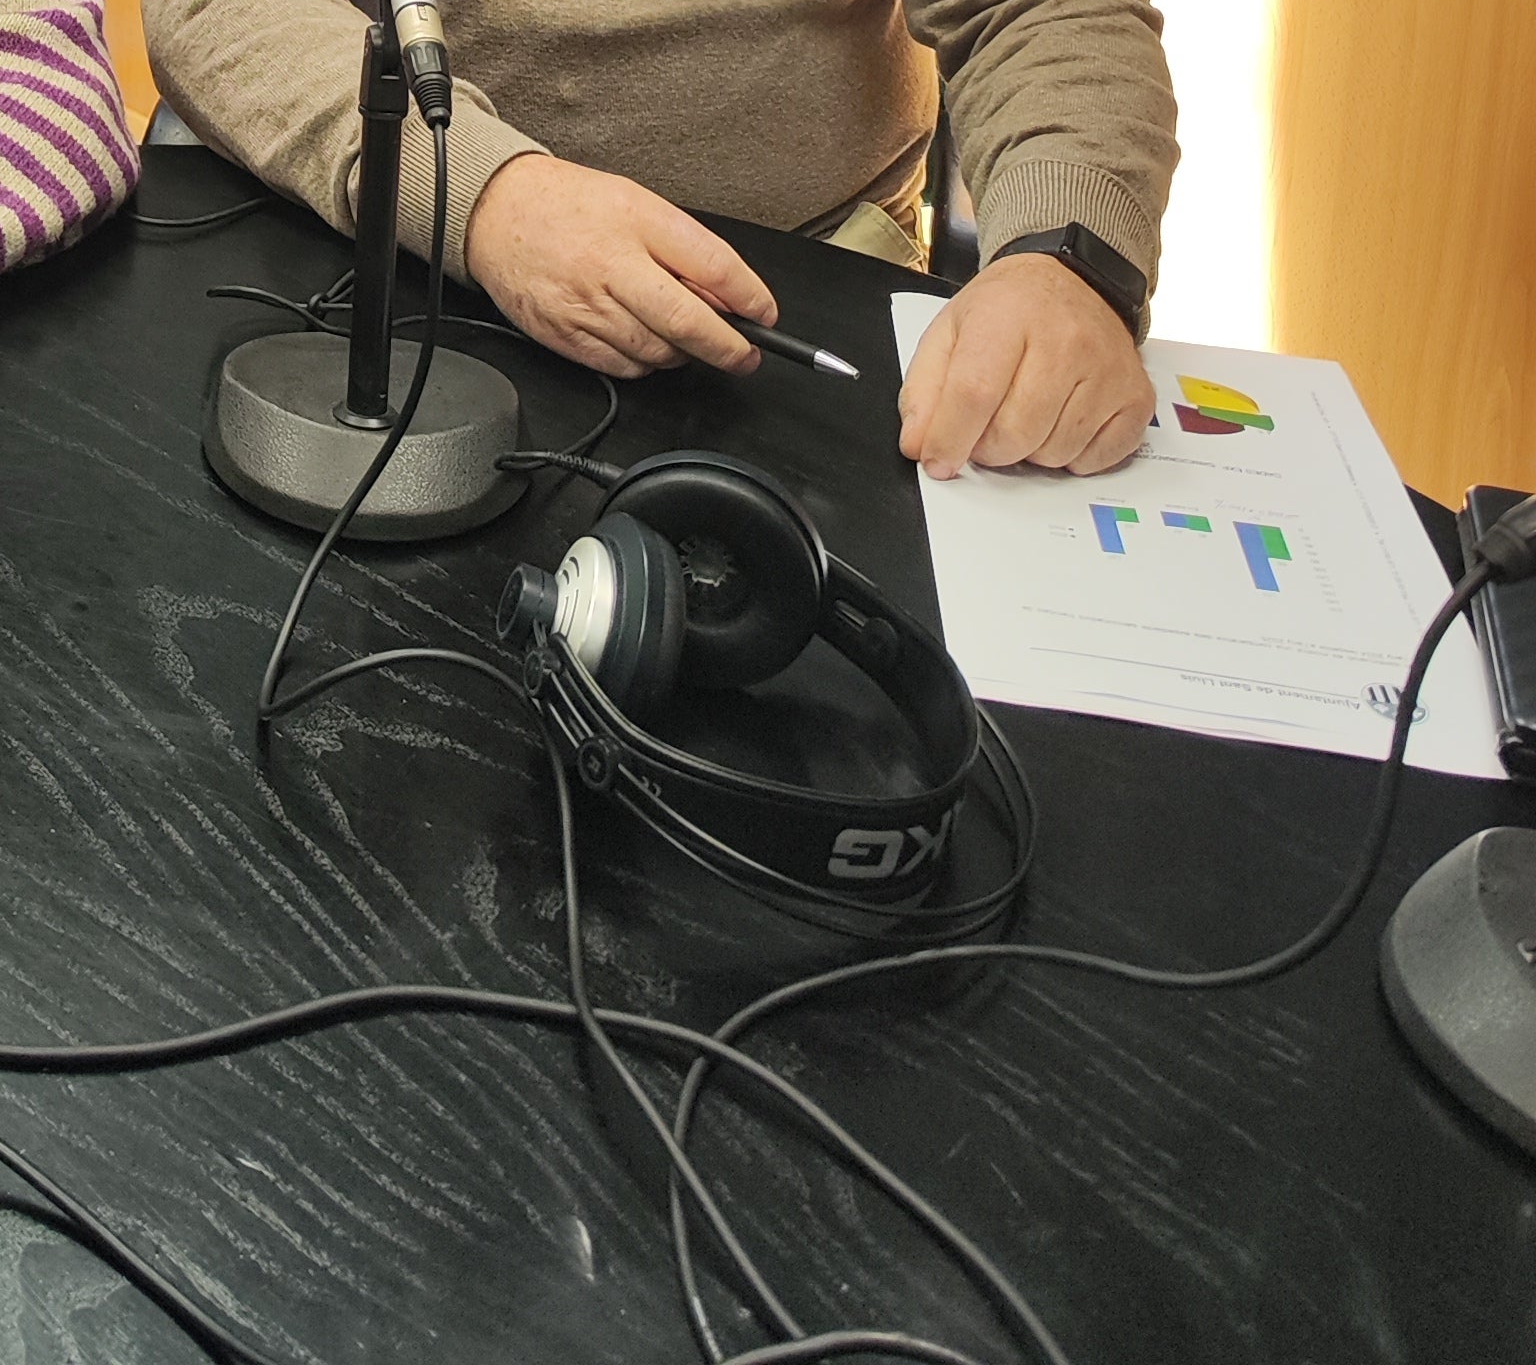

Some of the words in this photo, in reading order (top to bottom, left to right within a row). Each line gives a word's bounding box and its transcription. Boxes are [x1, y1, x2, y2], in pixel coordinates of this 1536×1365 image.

[1219, 679, 1252, 692] Sant
[1256, 684, 1274, 695] de
[1278, 689, 1361, 711] Ajuntament
[828, 804, 960, 878] KG
